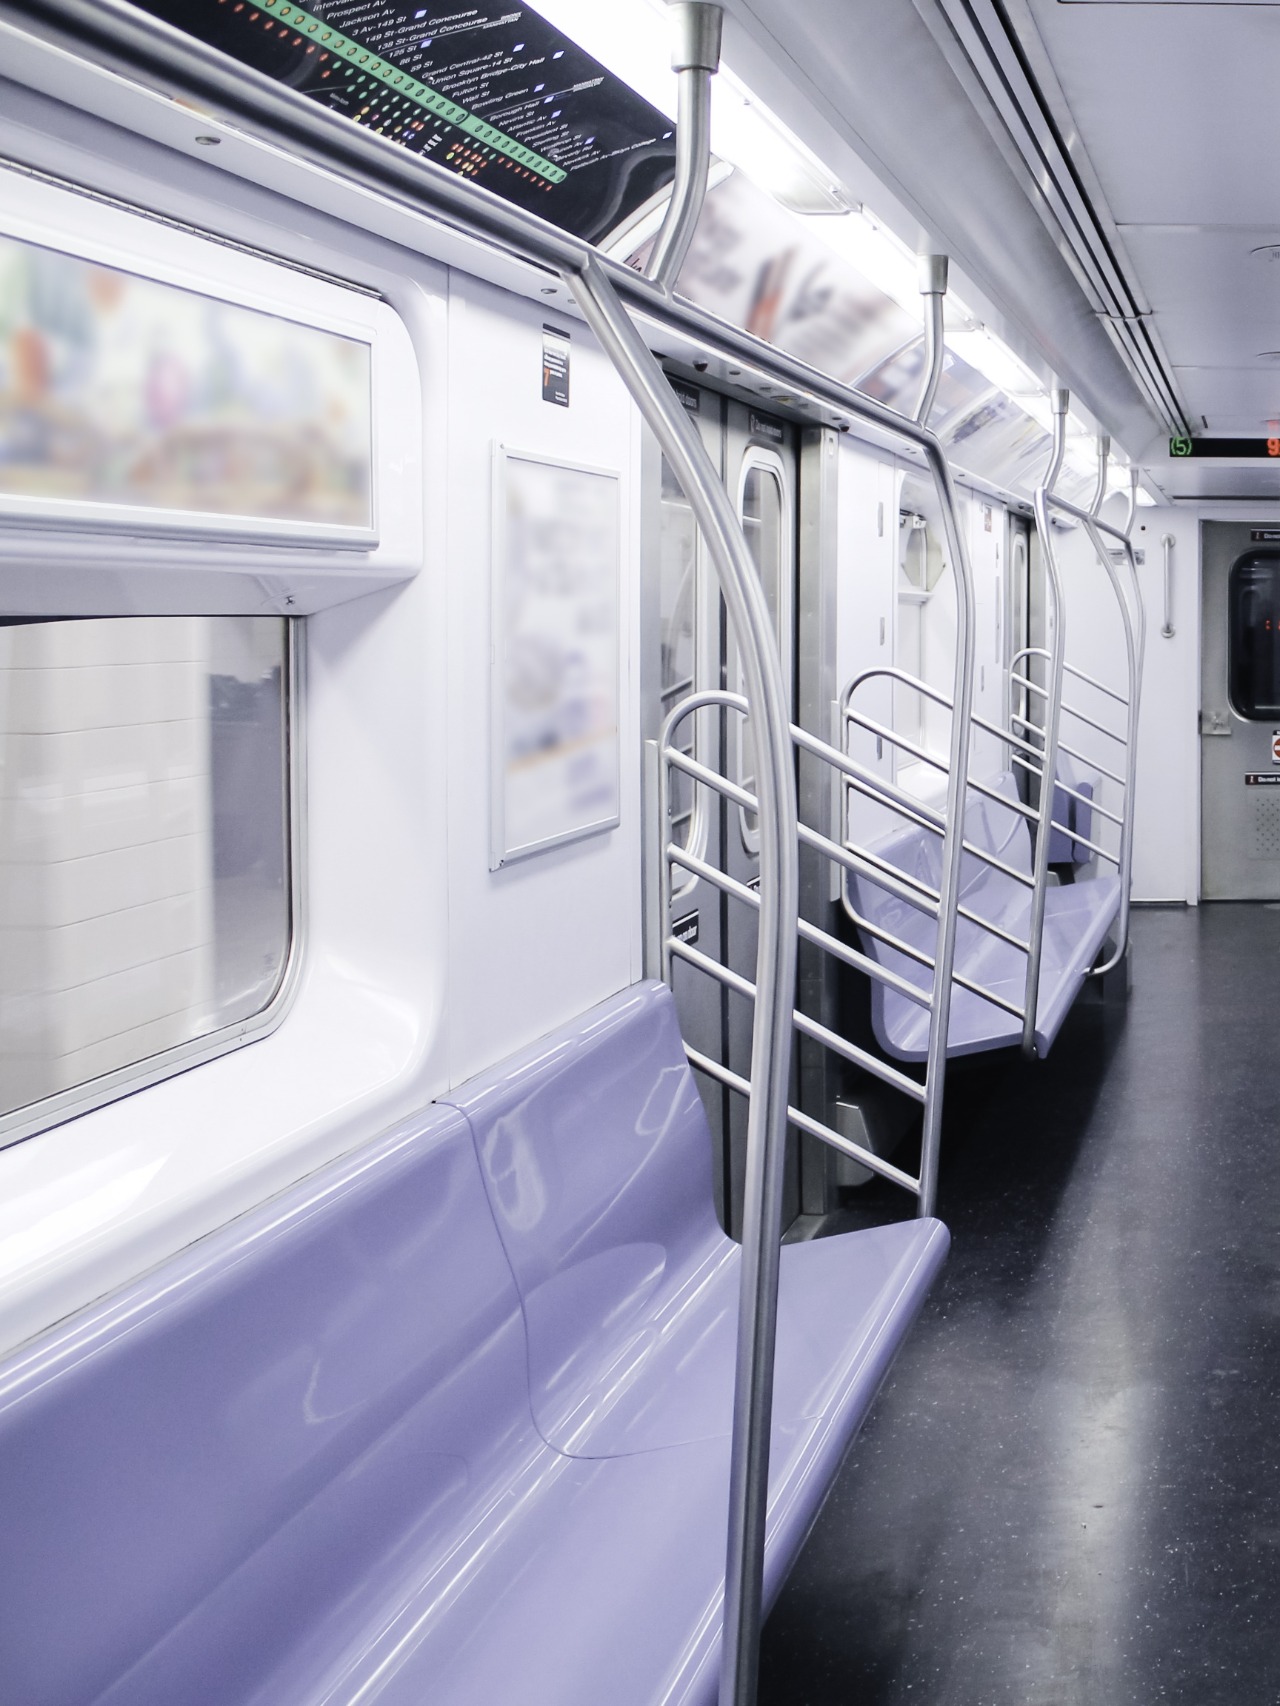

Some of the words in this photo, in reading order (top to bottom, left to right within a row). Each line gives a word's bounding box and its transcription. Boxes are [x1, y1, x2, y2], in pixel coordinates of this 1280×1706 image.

[326, 3, 370, 19] Prospect
[372, 0, 387, 8] Av
[339, 13, 379, 28] Jackson
[381, 8, 395, 16] Av
[366, 34, 382, 43] 149
[384, 21, 427, 37] St-Grand
[428, 9, 478, 26] Concourse
[352, 28, 359, 36] 3
[360, 18, 394, 33] Av-149
[395, 29, 438, 44] St-Grand
[439, 17, 488, 33] Concourse
[407, 45, 417, 53] St
[422, 66, 448, 78] Grand
[432, 74, 457, 85] Union
[442, 76, 479, 91] Brooklyn
[528, 57, 545, 66] Hall
[452, 86, 478, 98] Fulton
[462, 94, 479, 104] Wall
[472, 96, 503, 110] Bowling
